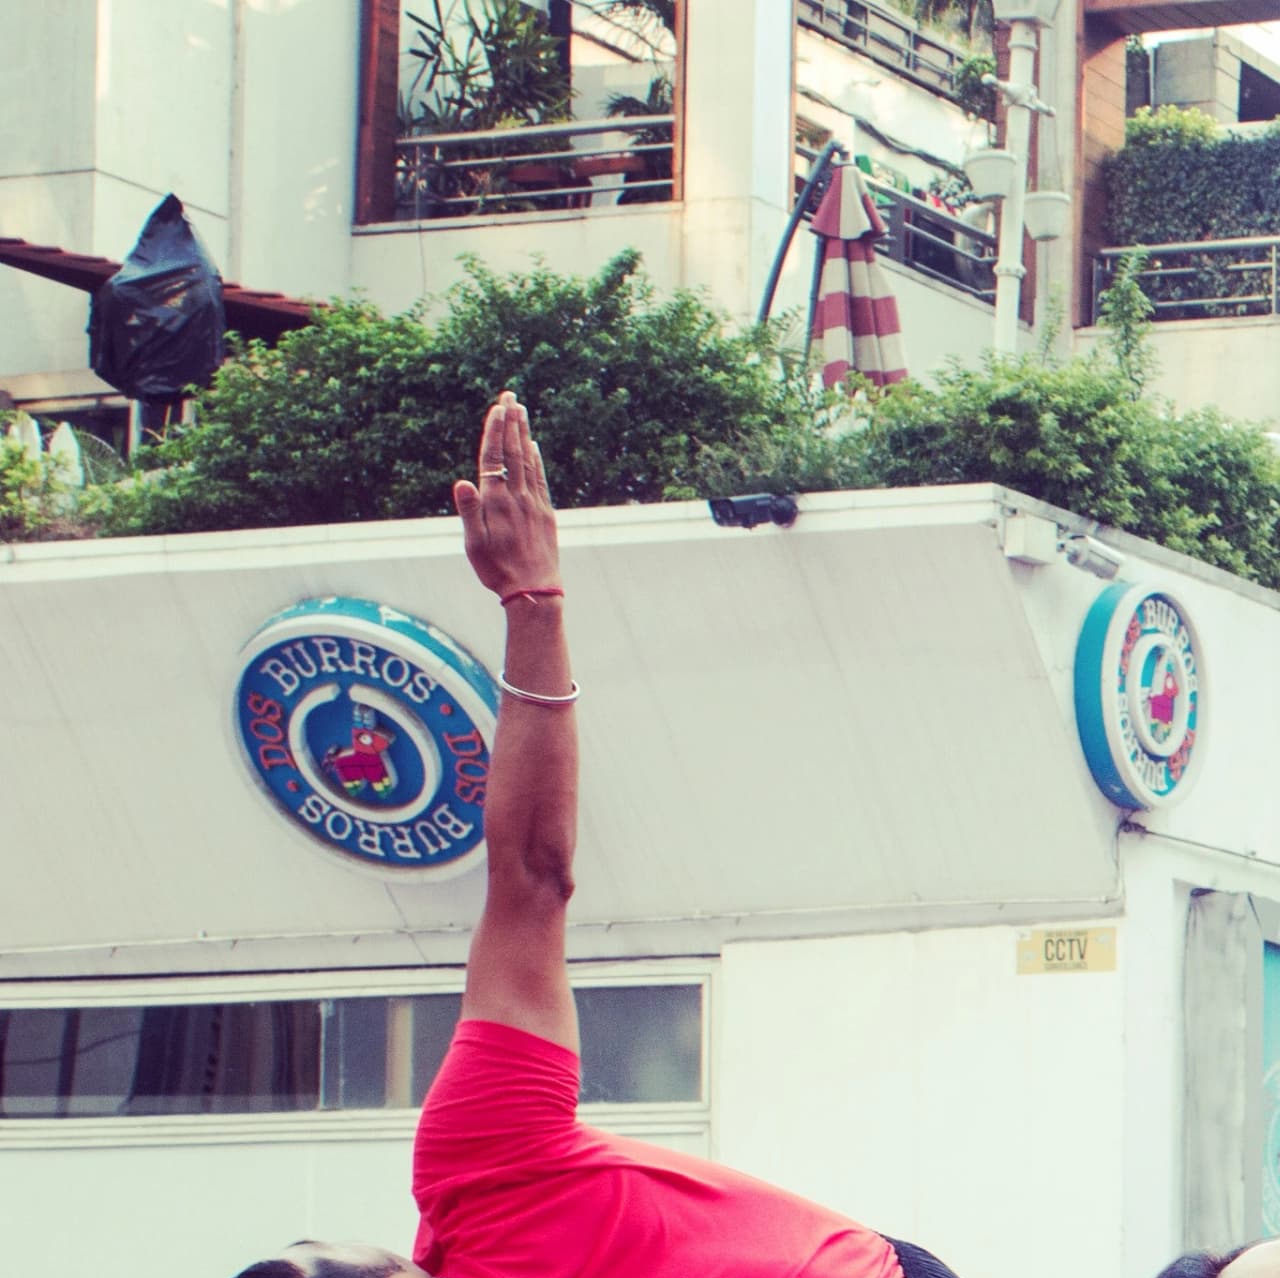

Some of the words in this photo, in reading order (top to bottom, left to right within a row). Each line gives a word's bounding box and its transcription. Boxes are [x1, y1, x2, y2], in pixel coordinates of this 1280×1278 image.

[260, 637, 438, 704] BURROS
[247, 692, 298, 770] DOS
[442, 729, 490, 807] DOS
[298, 793, 474, 860] BURROS
[1043, 937, 1089, 962] CCTV
